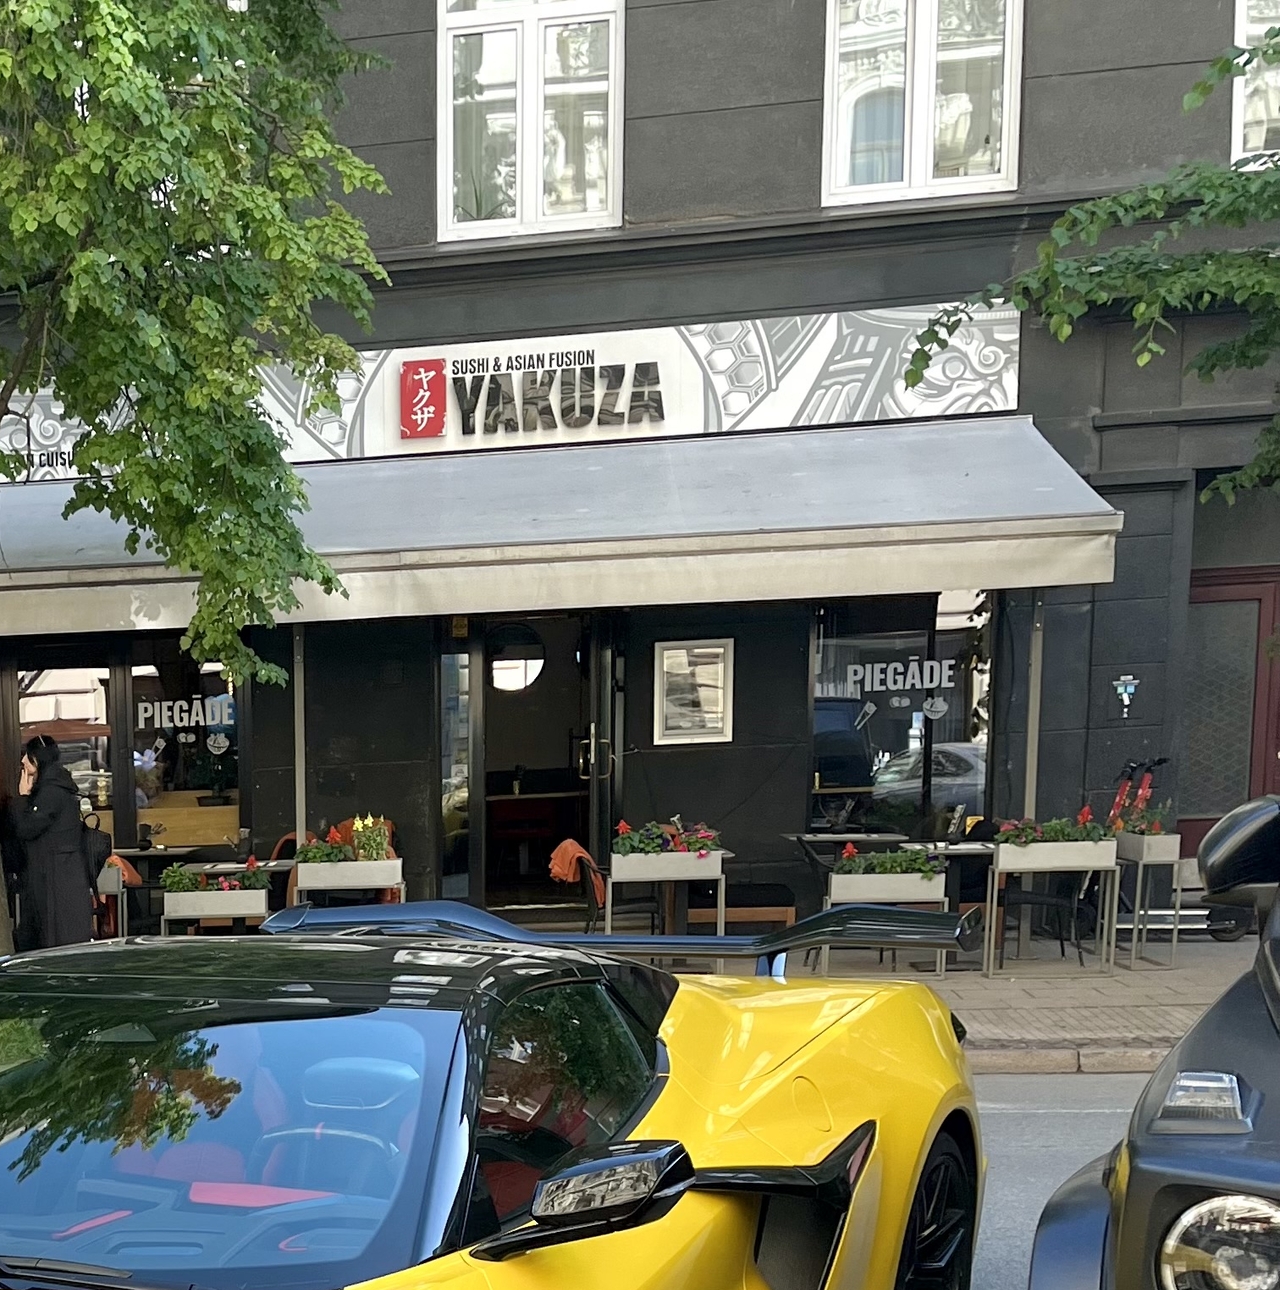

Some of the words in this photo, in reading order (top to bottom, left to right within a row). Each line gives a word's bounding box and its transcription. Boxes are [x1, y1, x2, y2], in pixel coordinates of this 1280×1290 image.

[451, 357, 489, 375] SUSHI
[493, 357, 502, 372] &
[505, 353, 546, 371] ASIAN
[549, 349, 595, 368] FUSION
[411, 367, 437, 432] ヤクザ
[451, 361, 665, 435] YAKUZA
[39, 451, 72, 468] CUISI
[847, 656, 956, 692] PIEGĀDE
[138, 694, 235, 729] PIEGĀDE
